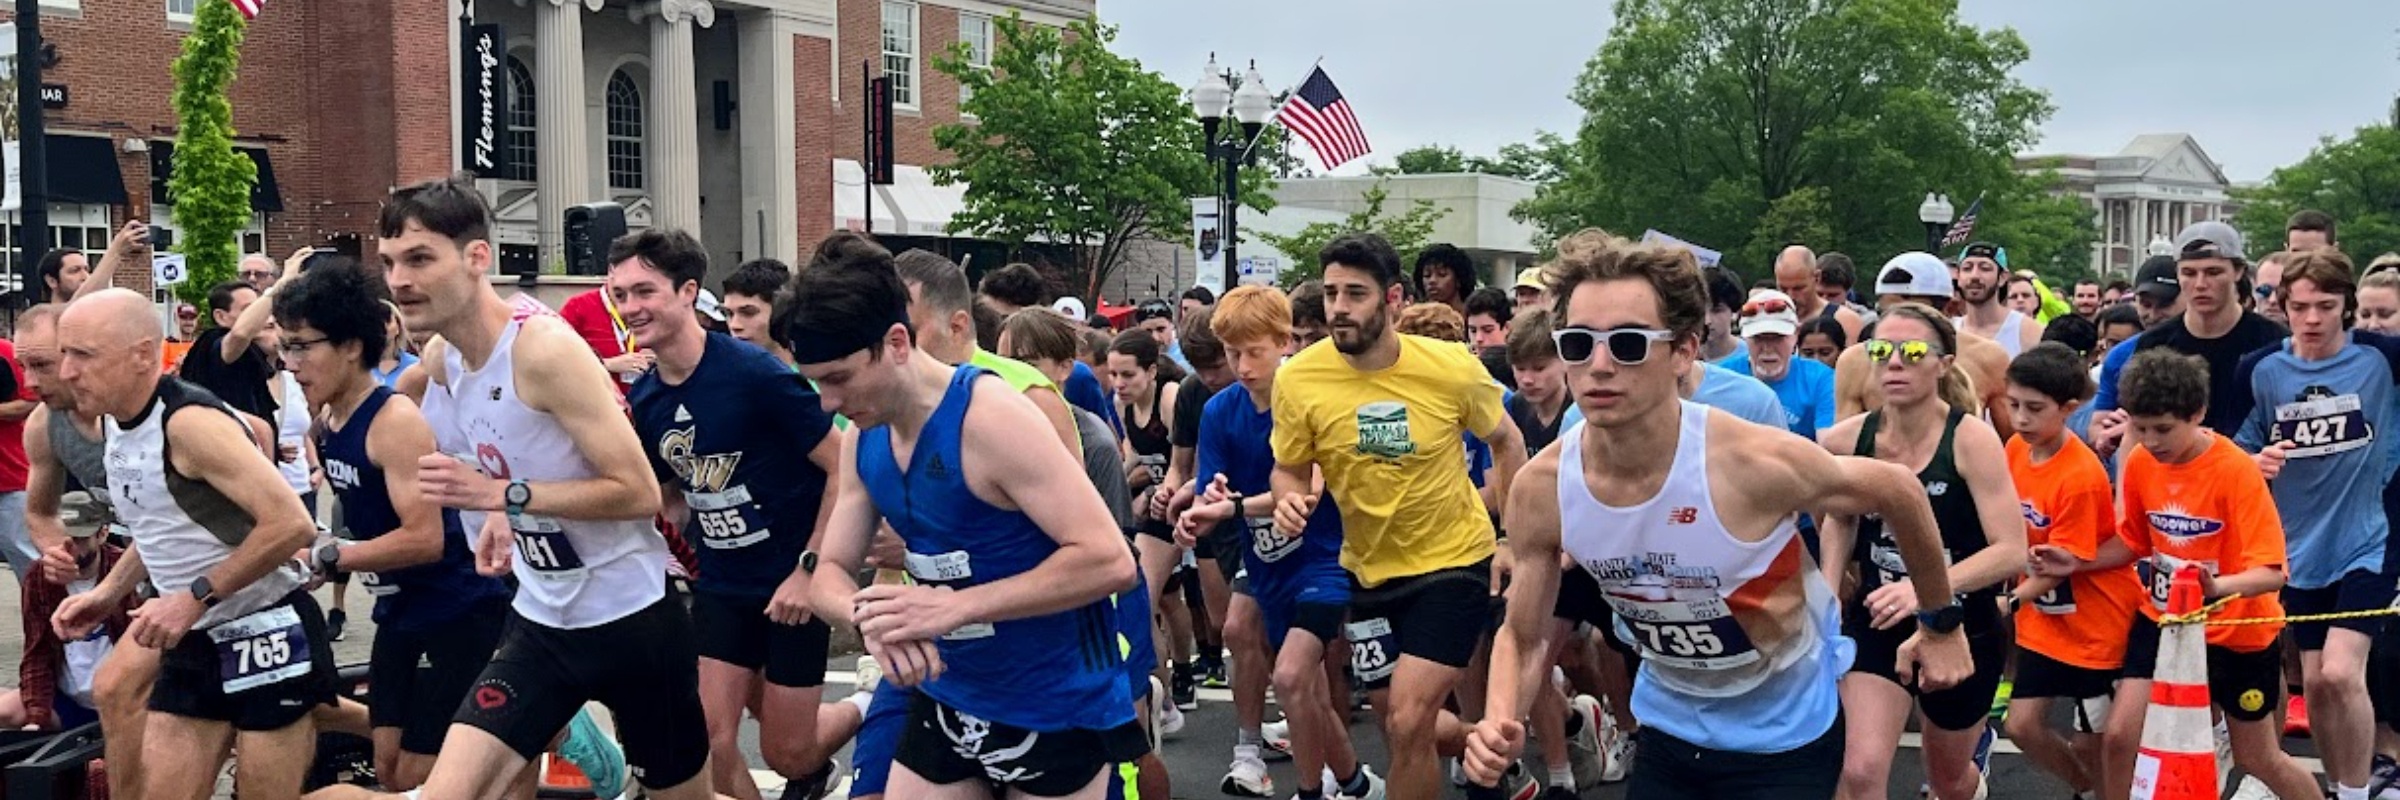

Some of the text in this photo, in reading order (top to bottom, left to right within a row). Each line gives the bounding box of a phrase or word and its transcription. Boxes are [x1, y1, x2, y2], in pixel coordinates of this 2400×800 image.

[475, 33, 498, 169] Fleming's
[2295, 416, 2347, 446] 427
[659, 425, 743, 494] GW
[698, 508, 747, 537] 655
[1668, 507, 1698, 525] NB
[232, 631, 291, 674] 765
[1350, 640, 1387, 669] 23
[1634, 622, 1724, 656] 735
